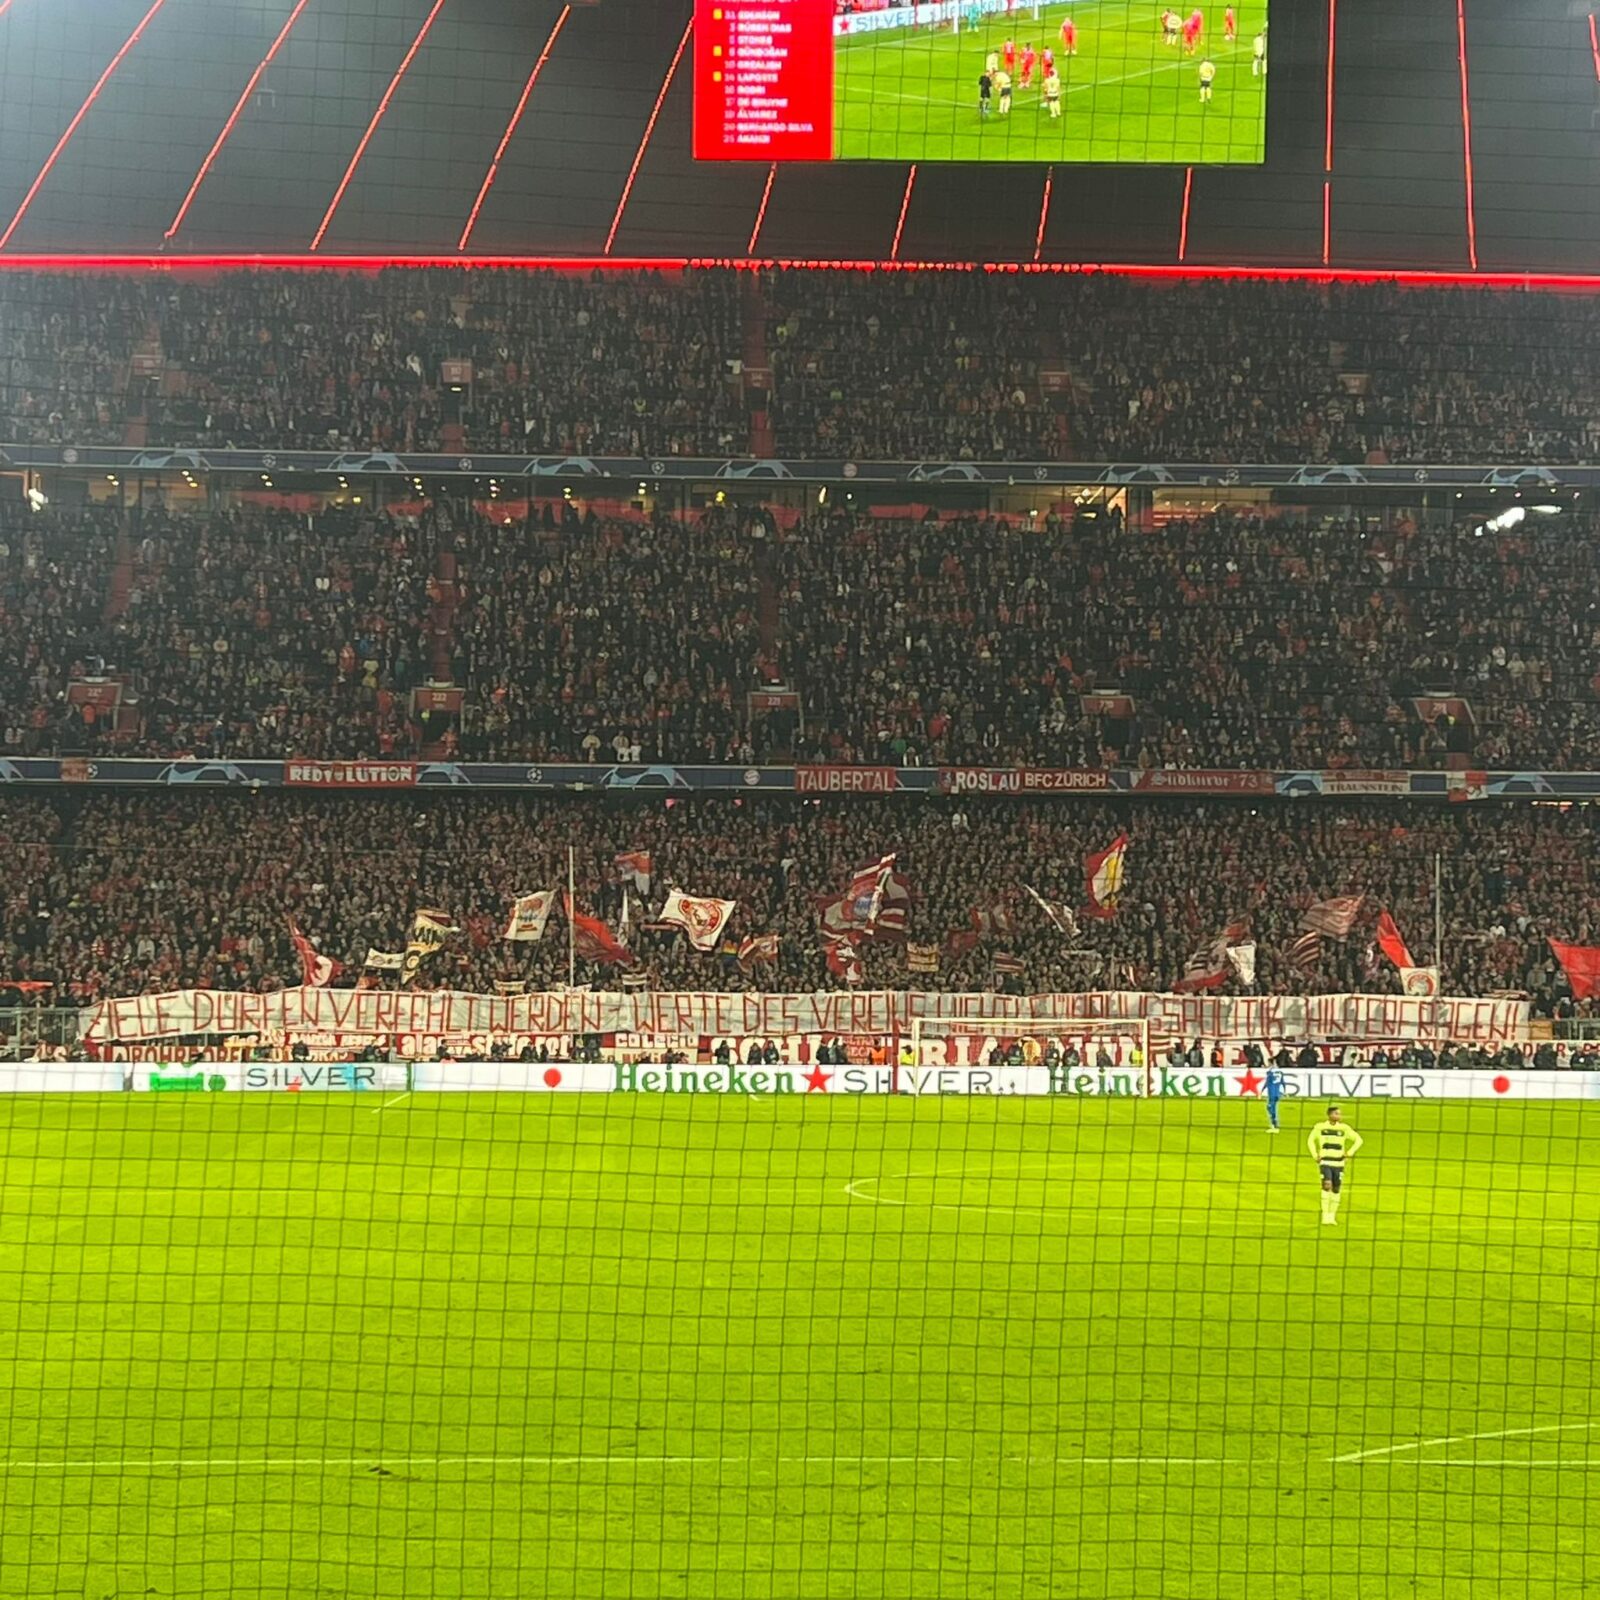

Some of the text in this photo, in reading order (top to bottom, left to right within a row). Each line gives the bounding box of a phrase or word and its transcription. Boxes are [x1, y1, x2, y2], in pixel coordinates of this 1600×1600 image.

[797, 770, 893, 791] TAUBERTAL
[956, 771, 1020, 790] RÖSLAU
[1024, 771, 1106, 787] BFC ZÜRICH
[1329, 783, 1403, 793] TRAUNSTEIN
[85, 995, 181, 1040] ZIELE
[193, 988, 319, 1031] DÜRFEN
[328, 991, 479, 1032] VERFEHLT
[489, 993, 600, 1032] WERDEN
[633, 993, 731, 1033] WERTE
[743, 995, 799, 1034] DES
[810, 994, 926, 1032] VEREINS
[1305, 997, 1519, 1041] HINTERFRAGEN!
[246, 1066, 375, 1088] SILVER
[613, 1061, 795, 1093] Heineken
[1279, 1071, 1425, 1098] SILVER
